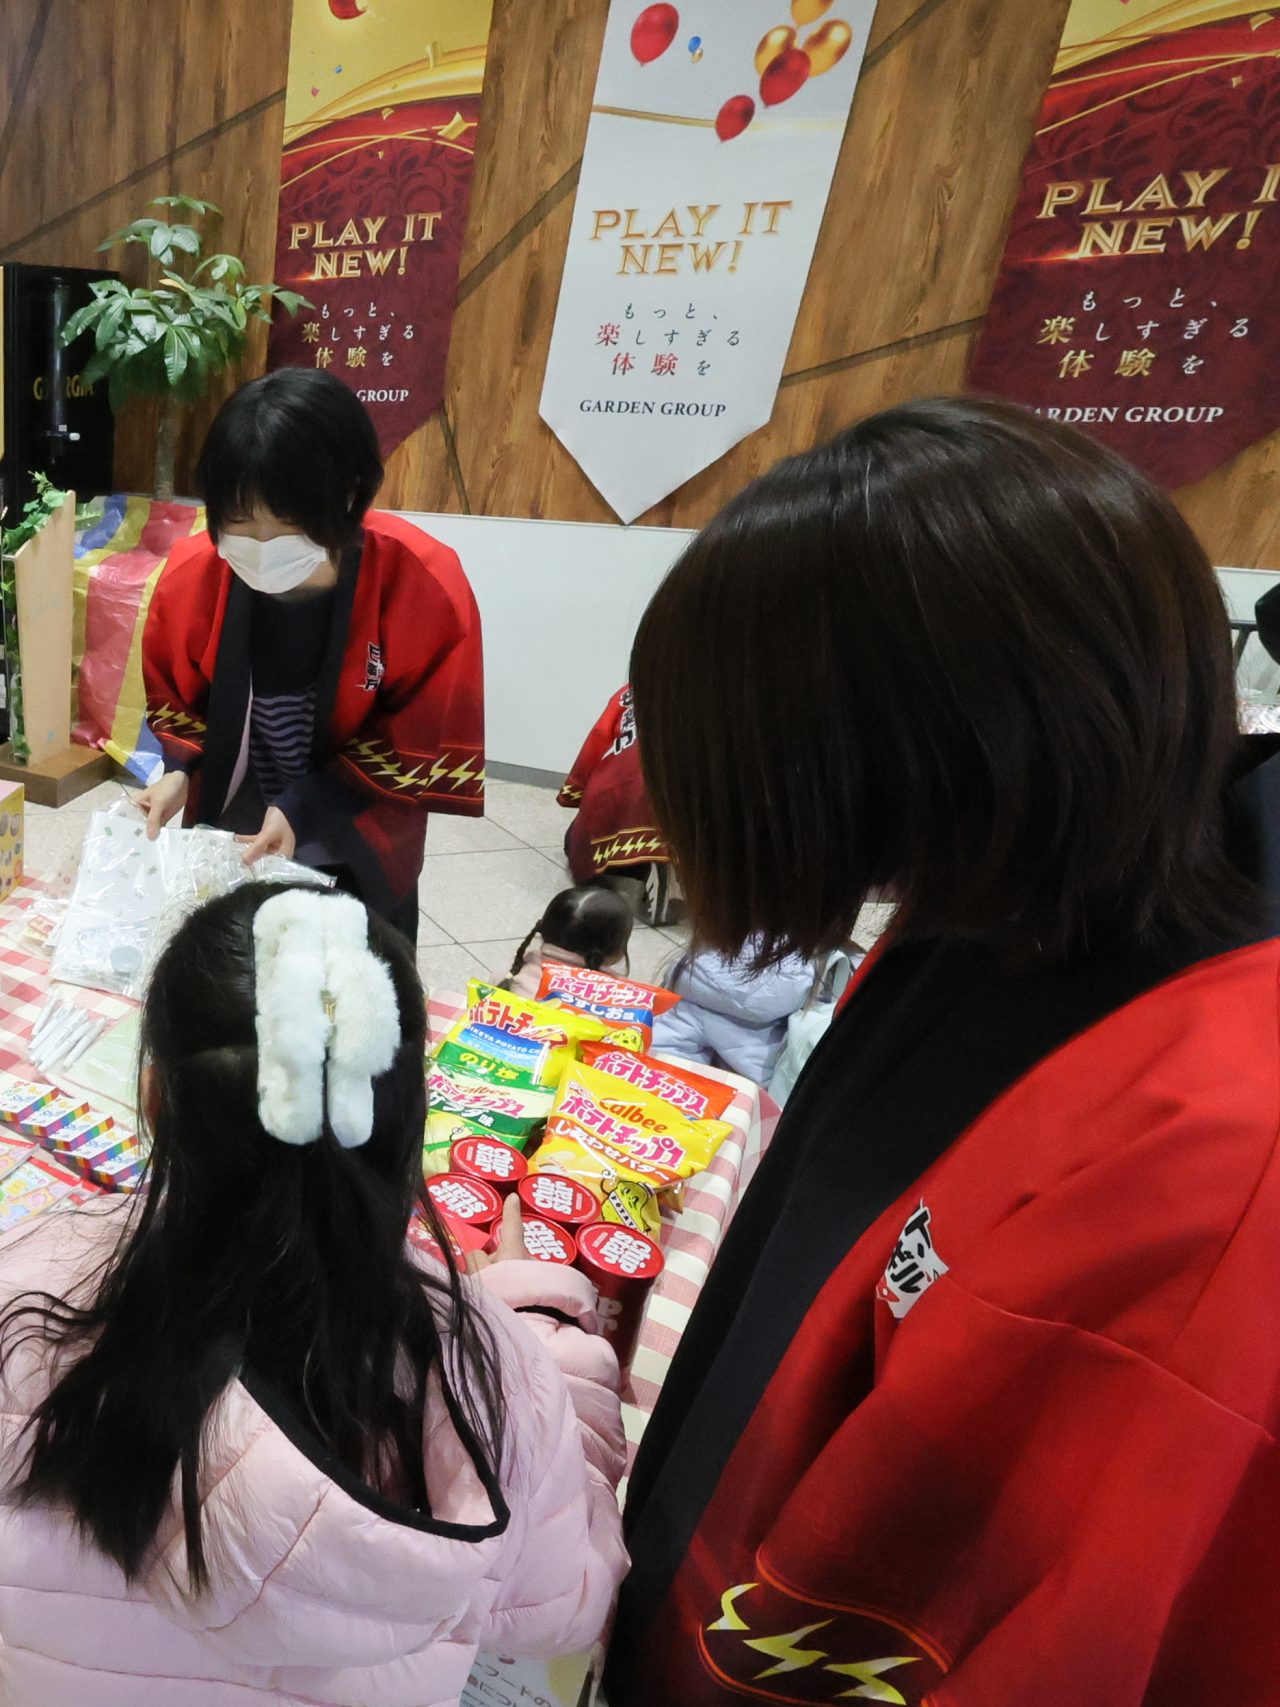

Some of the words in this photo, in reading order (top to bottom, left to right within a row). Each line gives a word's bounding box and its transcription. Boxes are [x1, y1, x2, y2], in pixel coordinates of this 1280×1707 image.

[1036, 167, 1233, 220] PLAY
[288, 216, 388, 250] PLAY
[403, 212, 442, 242] IT
[589, 204, 721, 241] PLAY
[737, 200, 793, 234] IT
[1077, 209, 1264, 256] NEW!
[313, 246, 410, 280] NEW!
[616, 240, 744, 275] NEW!
[302, 322, 415, 344] 楽しすぎる
[595, 323, 741, 347] 楽しすぎる
[1036, 315, 1250, 346] 楽しすぎる
[315, 346, 394, 369] 体験を
[611, 352, 711, 376] 体験を
[1058, 348, 1204, 378] 体験を
[357, 389, 410, 403] GROUP
[579, 400, 656, 415] GARDEN
[661, 402, 727, 417] GROUP
[1125, 406, 1224, 423] GROUP
[495, 1038, 528, 1054] POTATO
[592, 1051, 709, 1116] ポテトチップス
[599, 1097, 668, 1134] Calbee
[558, 1093, 686, 1170] ポテトチップス
